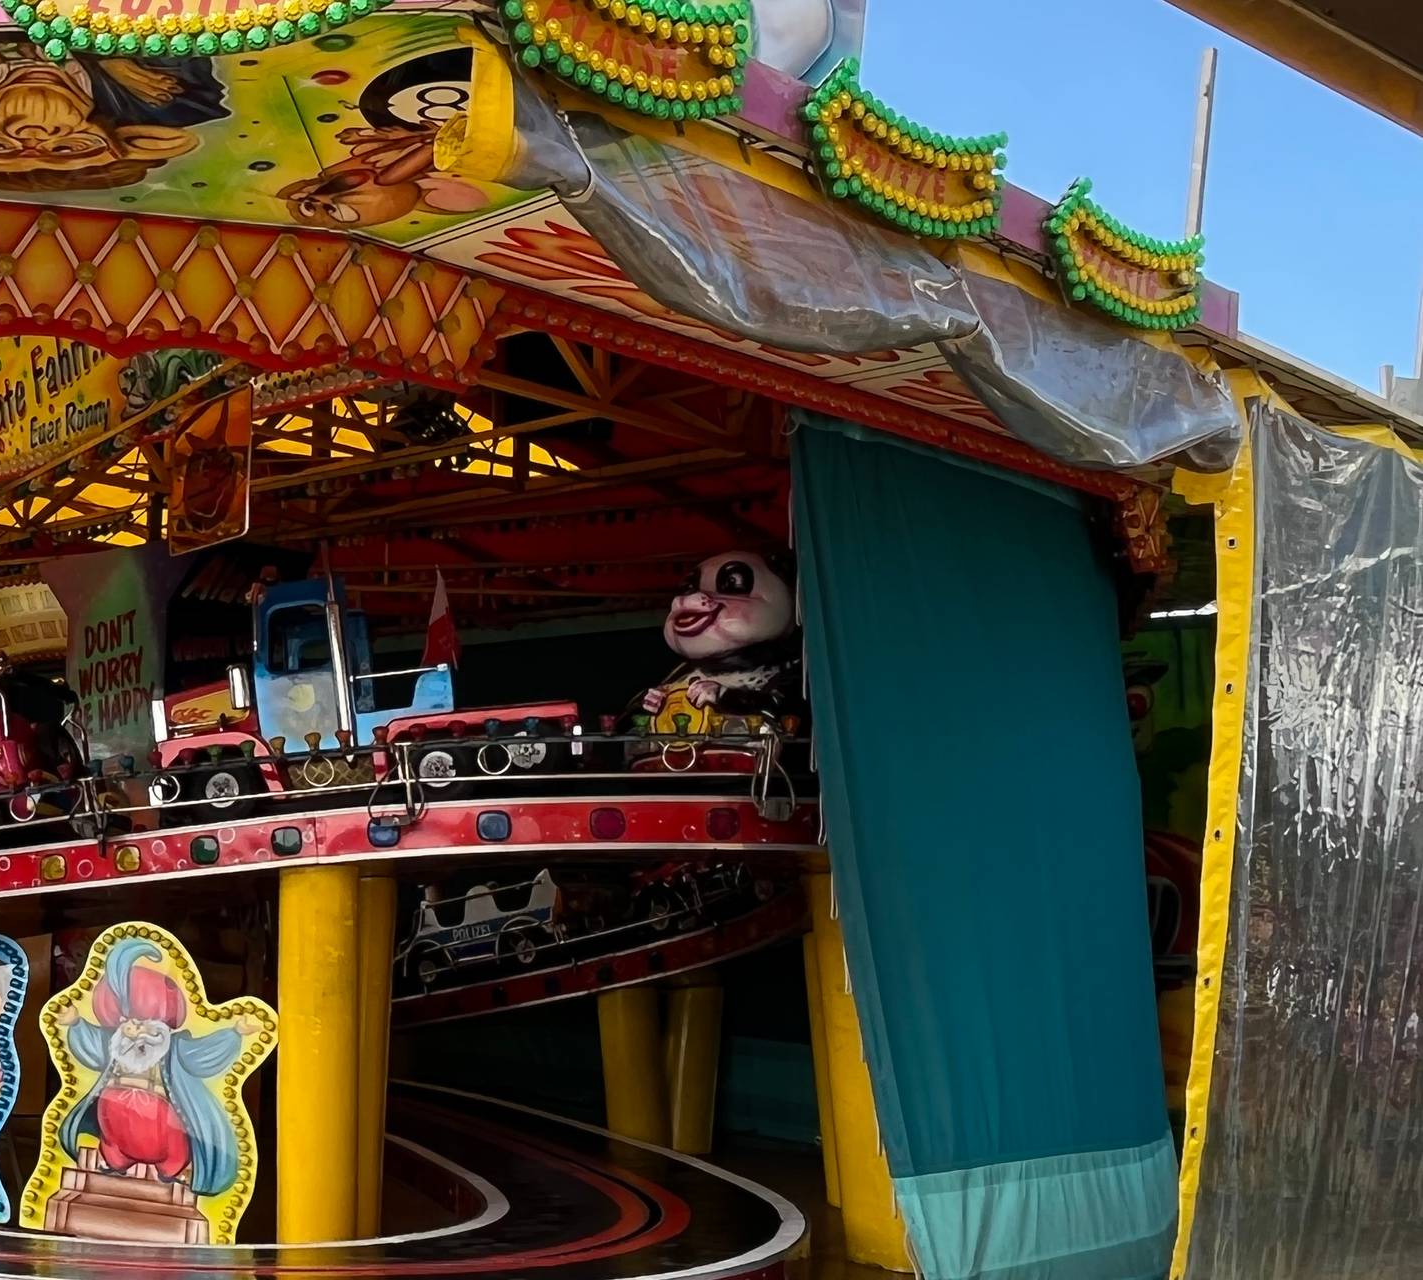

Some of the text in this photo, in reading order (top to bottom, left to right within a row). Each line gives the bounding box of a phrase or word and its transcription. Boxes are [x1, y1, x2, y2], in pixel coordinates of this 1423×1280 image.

[30, 398, 111, 449] Euer Ronny
[85, 609, 137, 660] DON'T
[79, 645, 143, 700] WORRY
[98, 681, 155, 732] HAPPY
